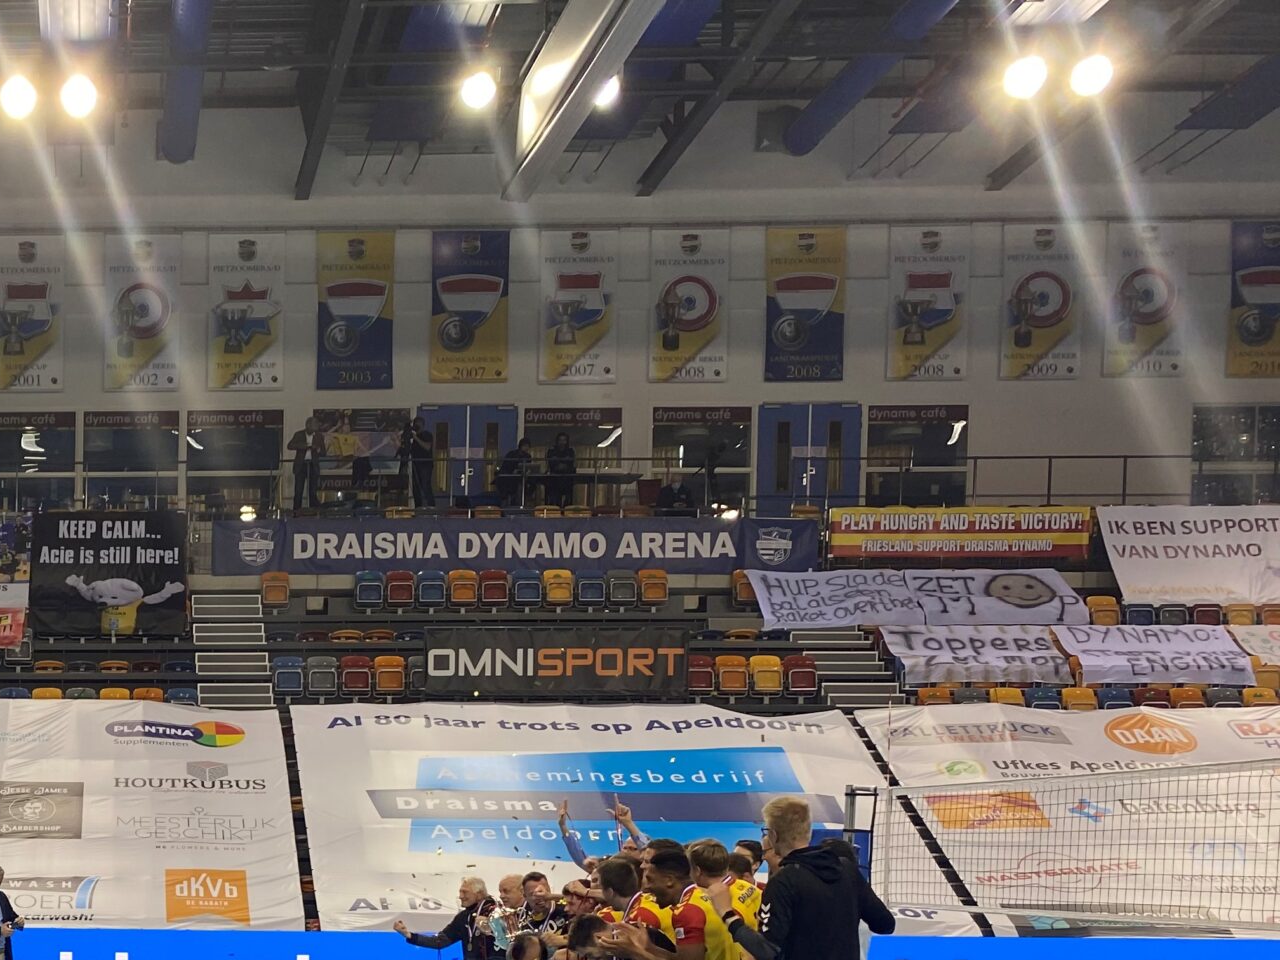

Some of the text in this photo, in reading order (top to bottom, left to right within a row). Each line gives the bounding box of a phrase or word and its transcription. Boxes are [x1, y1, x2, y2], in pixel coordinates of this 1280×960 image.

[452, 366, 486, 380] 2007
[561, 364, 595, 377] 2007
[671, 366, 706, 379] 2008
[786, 364, 821, 378] 2008
[910, 363, 945, 377] 2008
[1023, 363, 1058, 376] 2009
[10, 373, 42, 387] 2001
[128, 373, 159, 387] 2002
[230, 372, 263, 386] 2003
[337, 371, 373, 385] 2003
[841, 512, 1083, 531] PLAY HUNGRY AND TASTE VICTORY!
[1107, 519, 1129, 535] IK
[1132, 519, 1176, 536] BEN
[58, 519, 162, 539] KEEP CALM...
[292, 531, 738, 560] DRAISMA DYNAMO ARENA
[861, 539, 1053, 552] FRIESLAND SUPPORT DRAISMA DYNAMO
[1112, 543, 1263, 559] VAN DYNAMO
[39, 545, 179, 564] Acie is still here!
[912, 576, 976, 596] ZET
[427, 647, 686, 678] OMNISPORT
[1126, 655, 1247, 676] ENGINE
[113, 725, 195, 737] PLANTINA
[374, 714, 412, 726] 80
[423, 714, 486, 729] jaar
[497, 718, 580, 731] trots
[591, 722, 633, 735] op
[645, 716, 826, 735] Apeldoorn
[1111, 724, 1190, 746] DAAN
[113, 738, 190, 748] Supplementen
[992, 759, 1062, 771] Ufkes
[113, 777, 267, 790] HOUTKUBUS
[395, 795, 558, 812] Draisma
[116, 815, 277, 829] MEESTERLIJK
[134, 828, 260, 841] GESCHIKT
[975, 860, 1143, 884] MASTERMATE
[8, 880, 73, 889] WASH
